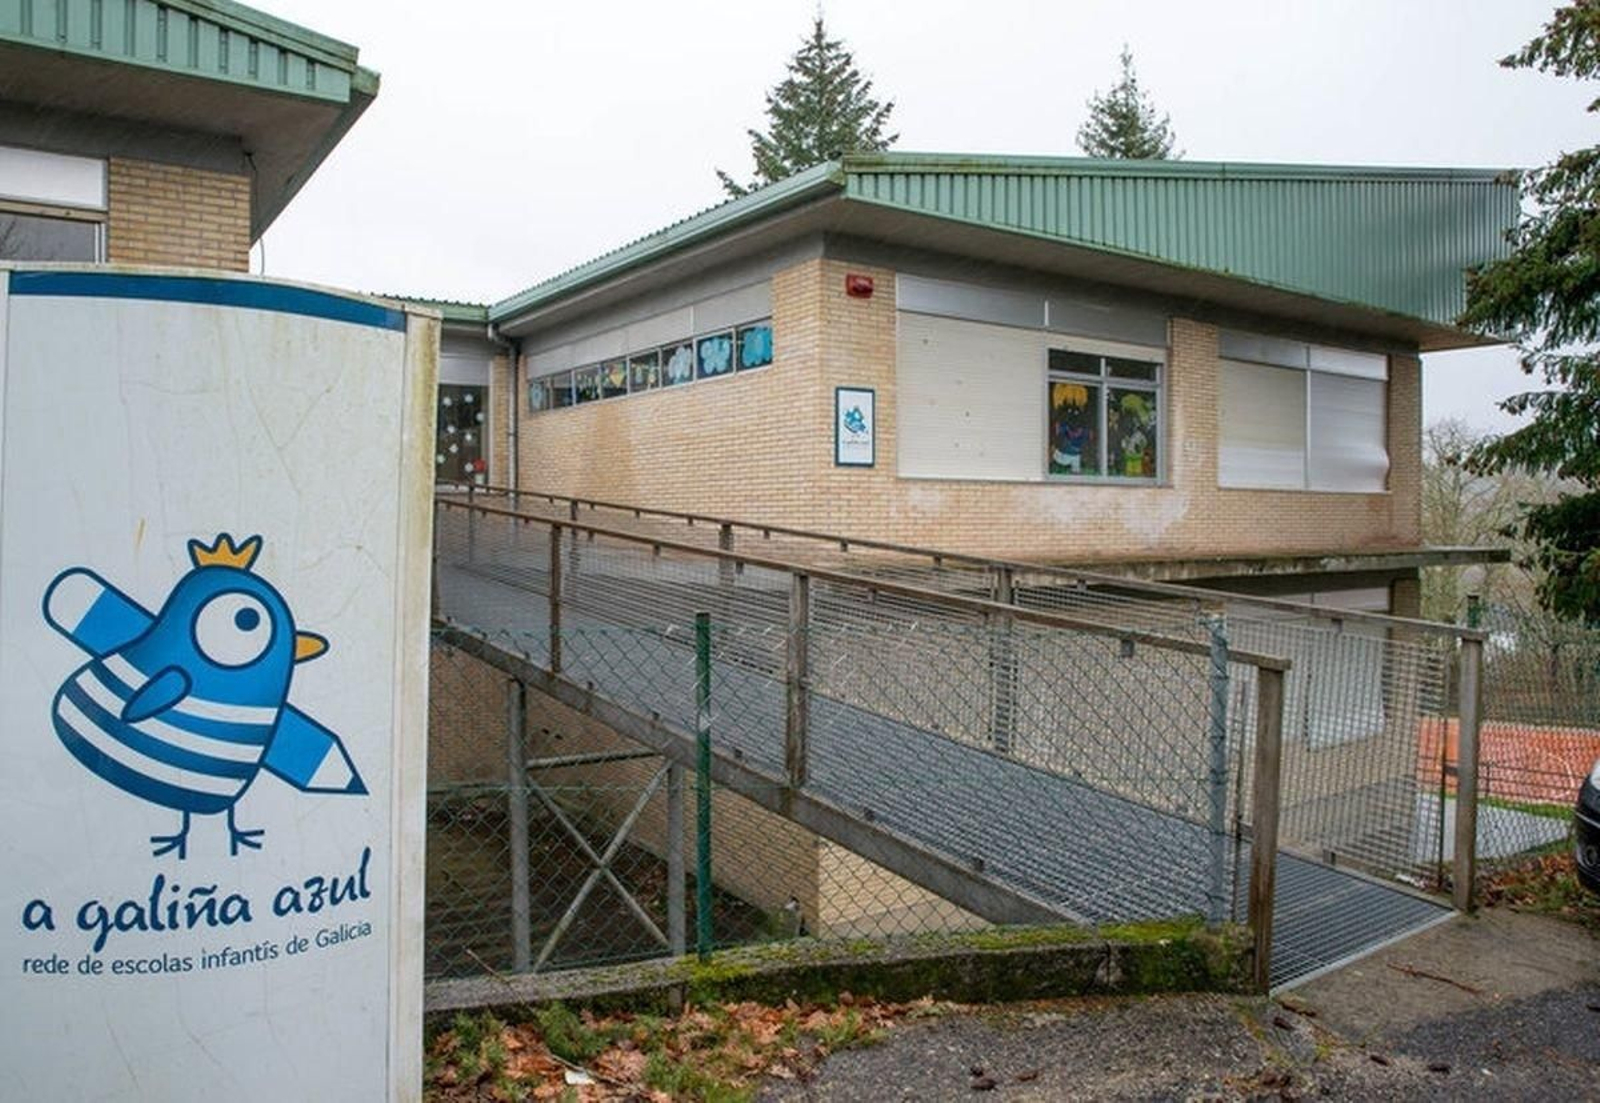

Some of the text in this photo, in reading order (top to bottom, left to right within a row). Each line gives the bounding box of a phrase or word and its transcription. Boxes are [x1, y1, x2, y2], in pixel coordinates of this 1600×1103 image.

[22, 846, 372, 954] a galiña azul
[22, 953, 70, 975] rede
[77, 954, 104, 976] de
[111, 952, 194, 975] escolas
[286, 935, 309, 955] de
[315, 921, 372, 949] Galicia
